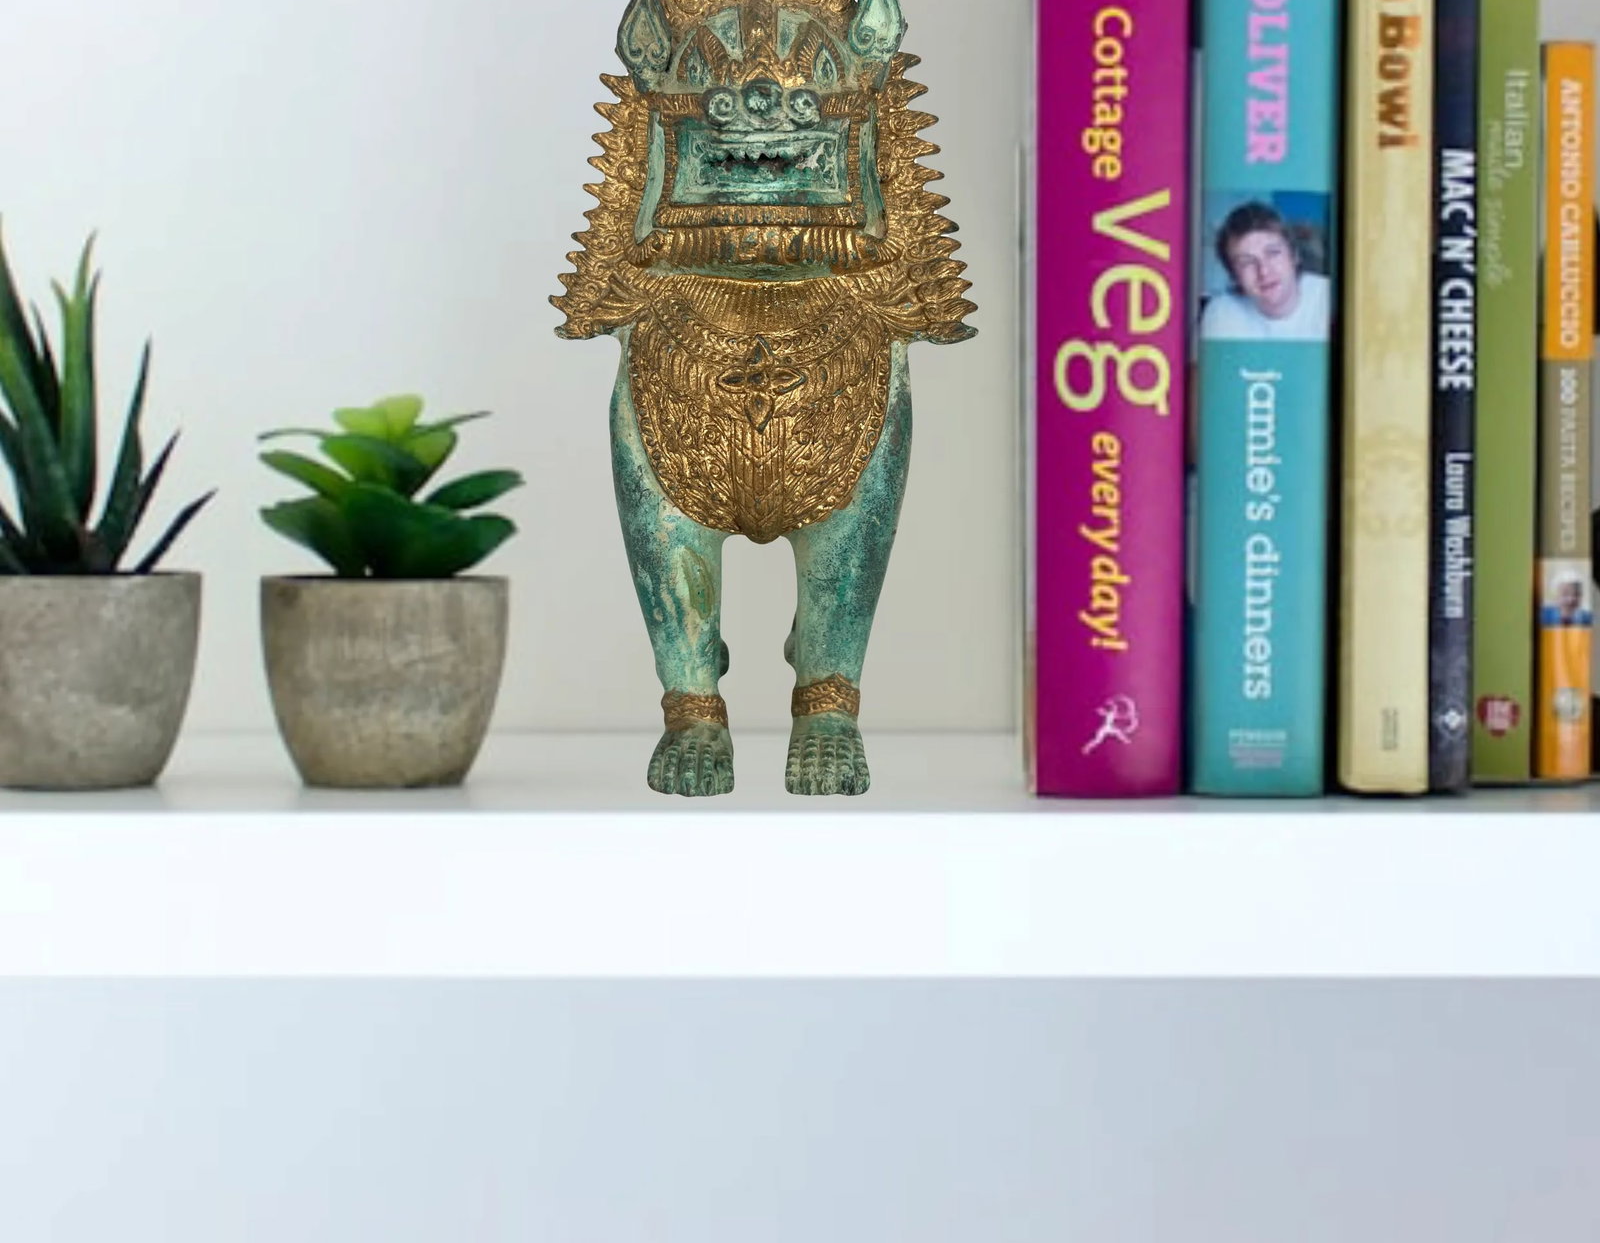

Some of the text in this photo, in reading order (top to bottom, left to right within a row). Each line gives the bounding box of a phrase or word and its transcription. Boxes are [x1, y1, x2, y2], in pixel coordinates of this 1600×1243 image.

[1081, 7, 1133, 179] Cottage
[1377, 14, 1422, 150] Bowl
[1504, 69, 1530, 169] Italian
[1441, 148, 1475, 221] MAC
[1054, 189, 1172, 415] Veg
[1438, 277, 1475, 392] CHEESE
[1443, 452, 1472, 511] Laura
[1243, 533, 1280, 700] dinners
